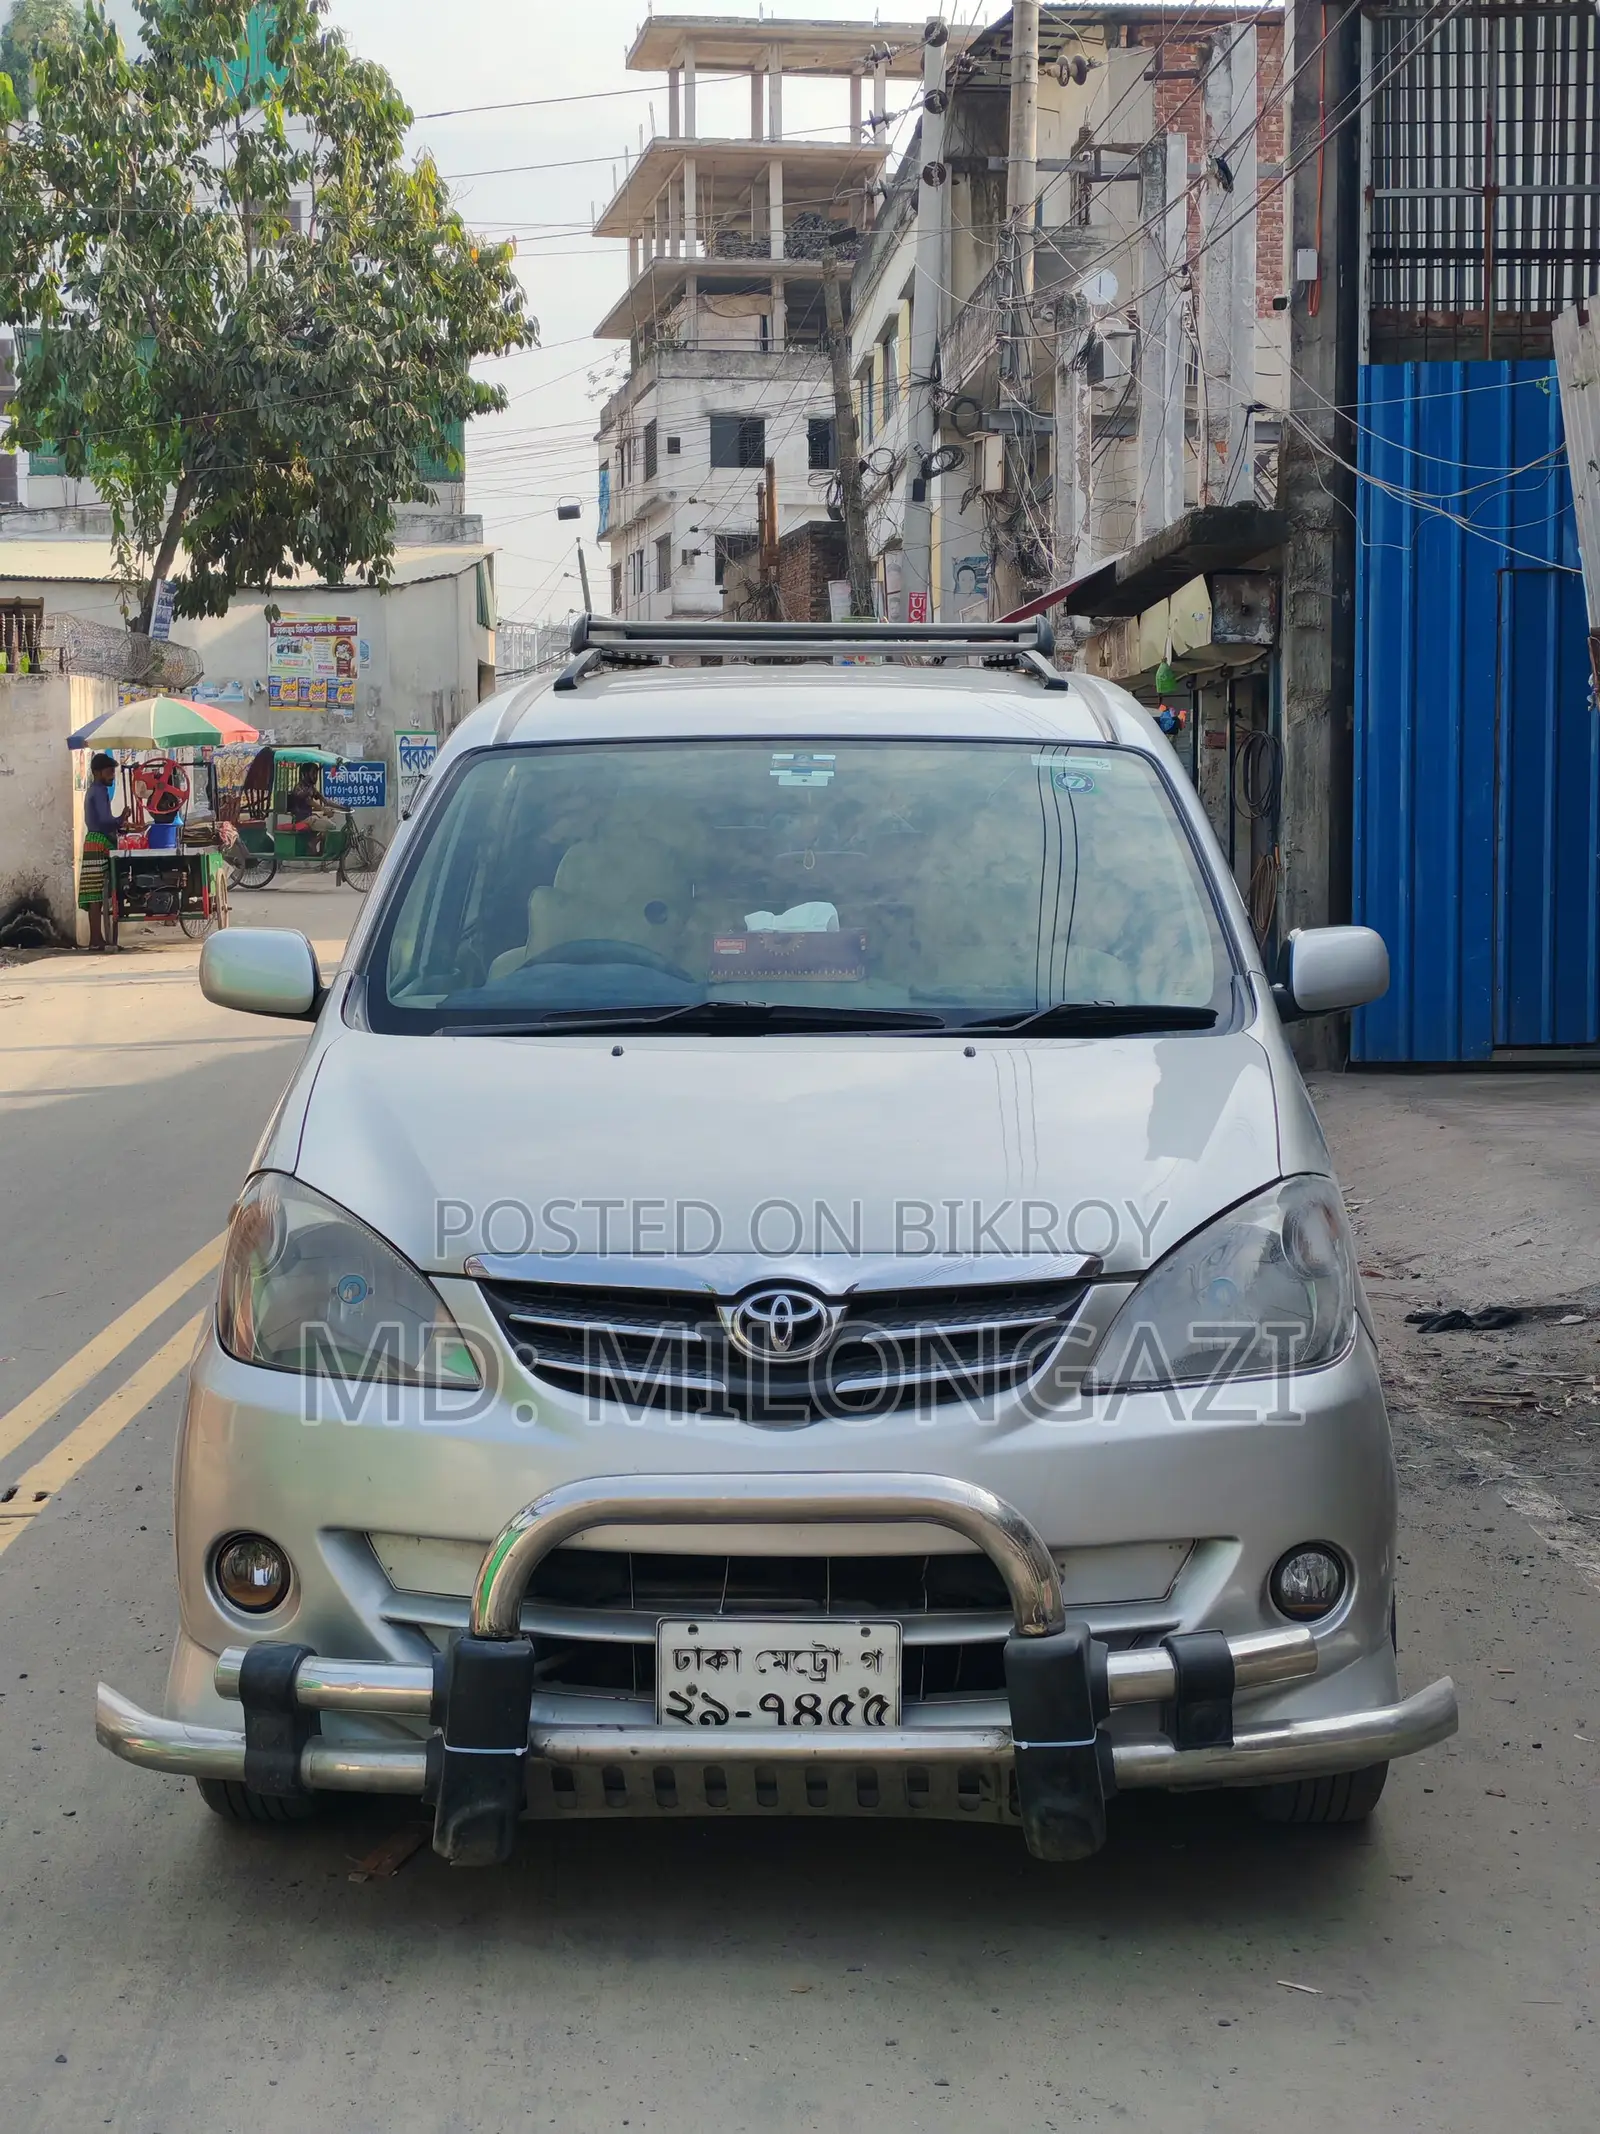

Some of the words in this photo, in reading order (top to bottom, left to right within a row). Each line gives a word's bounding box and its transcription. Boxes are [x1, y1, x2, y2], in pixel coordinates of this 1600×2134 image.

[672, 1645, 743, 1673] ঢাকা
[754, 1641, 843, 1683] মেট্রো
[860, 1648, 884, 1673] গ
